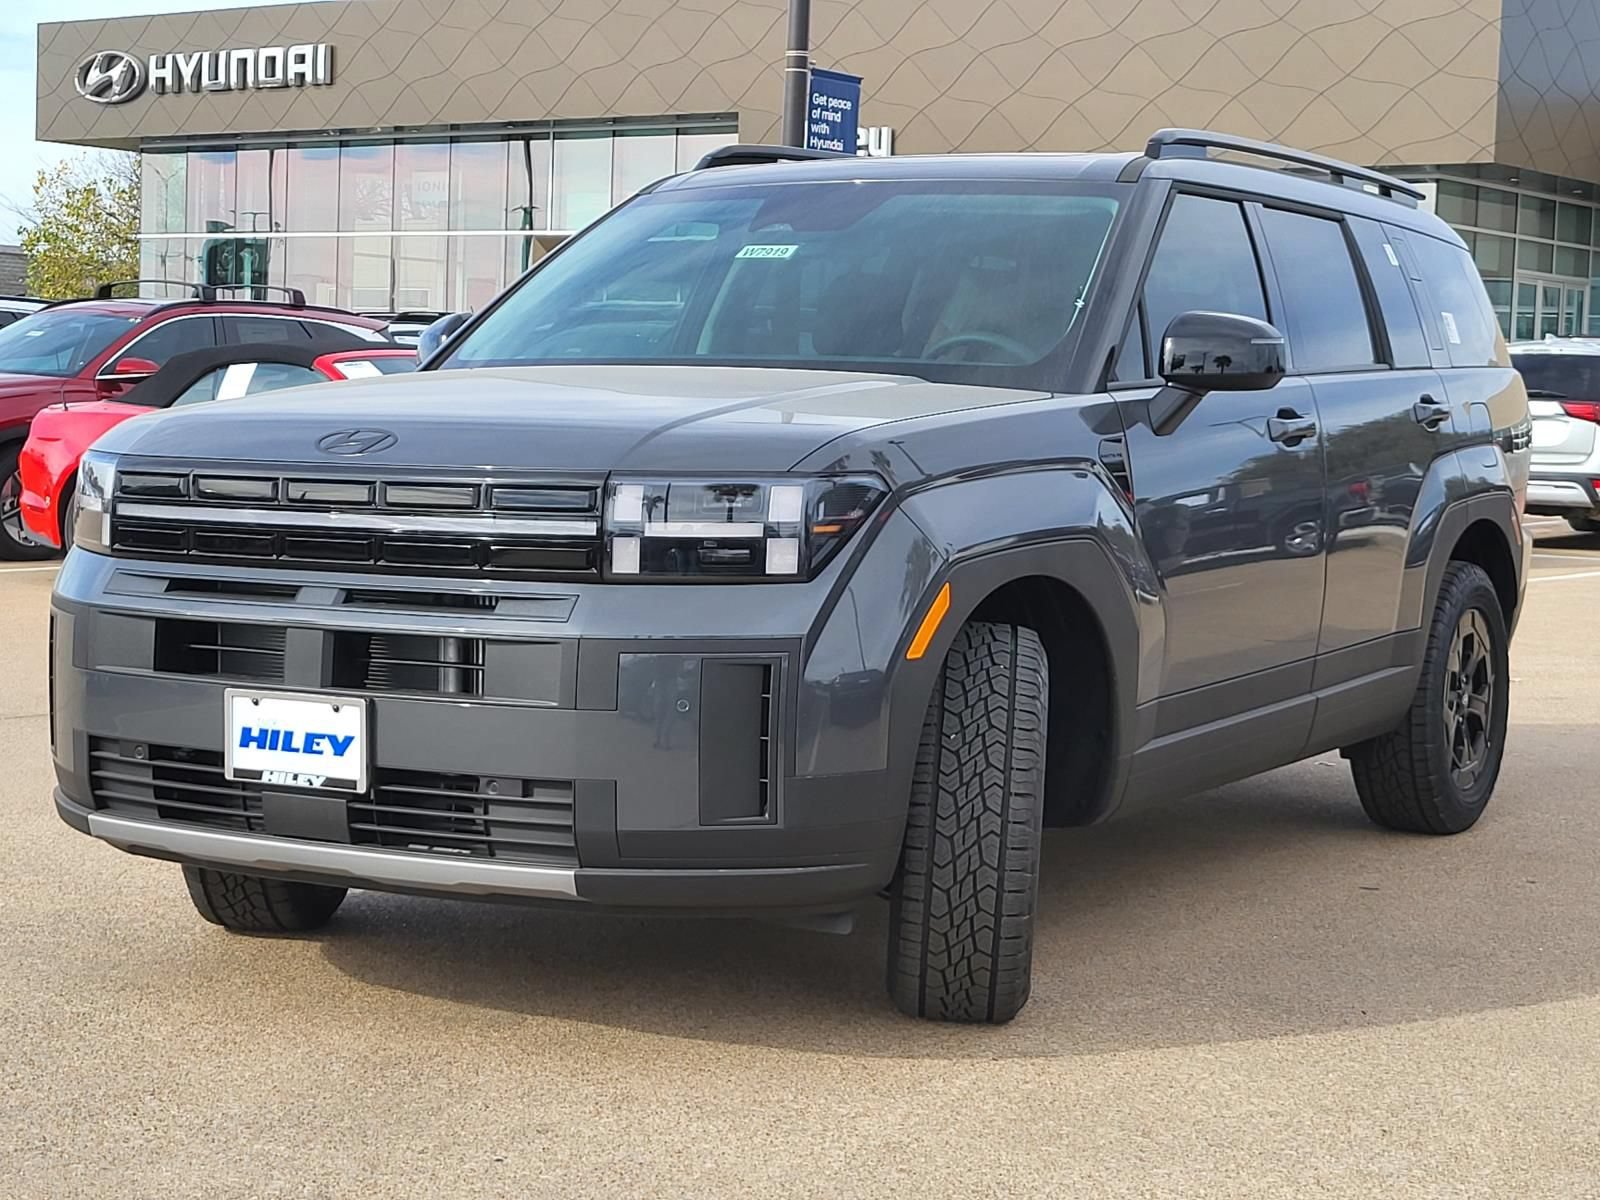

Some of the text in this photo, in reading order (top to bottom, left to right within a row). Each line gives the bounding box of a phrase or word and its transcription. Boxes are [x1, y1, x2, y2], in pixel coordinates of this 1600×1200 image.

[149, 43, 333, 93] HYUNDAI
[812, 93, 852, 110] Get peace
[811, 107, 842, 122] of mind
[810, 122, 830, 134] with
[810, 136, 844, 151] Hyundai
[742, 247, 790, 257] W7919
[238, 726, 355, 757] HILEY
[261, 769, 328, 788] HILEY
